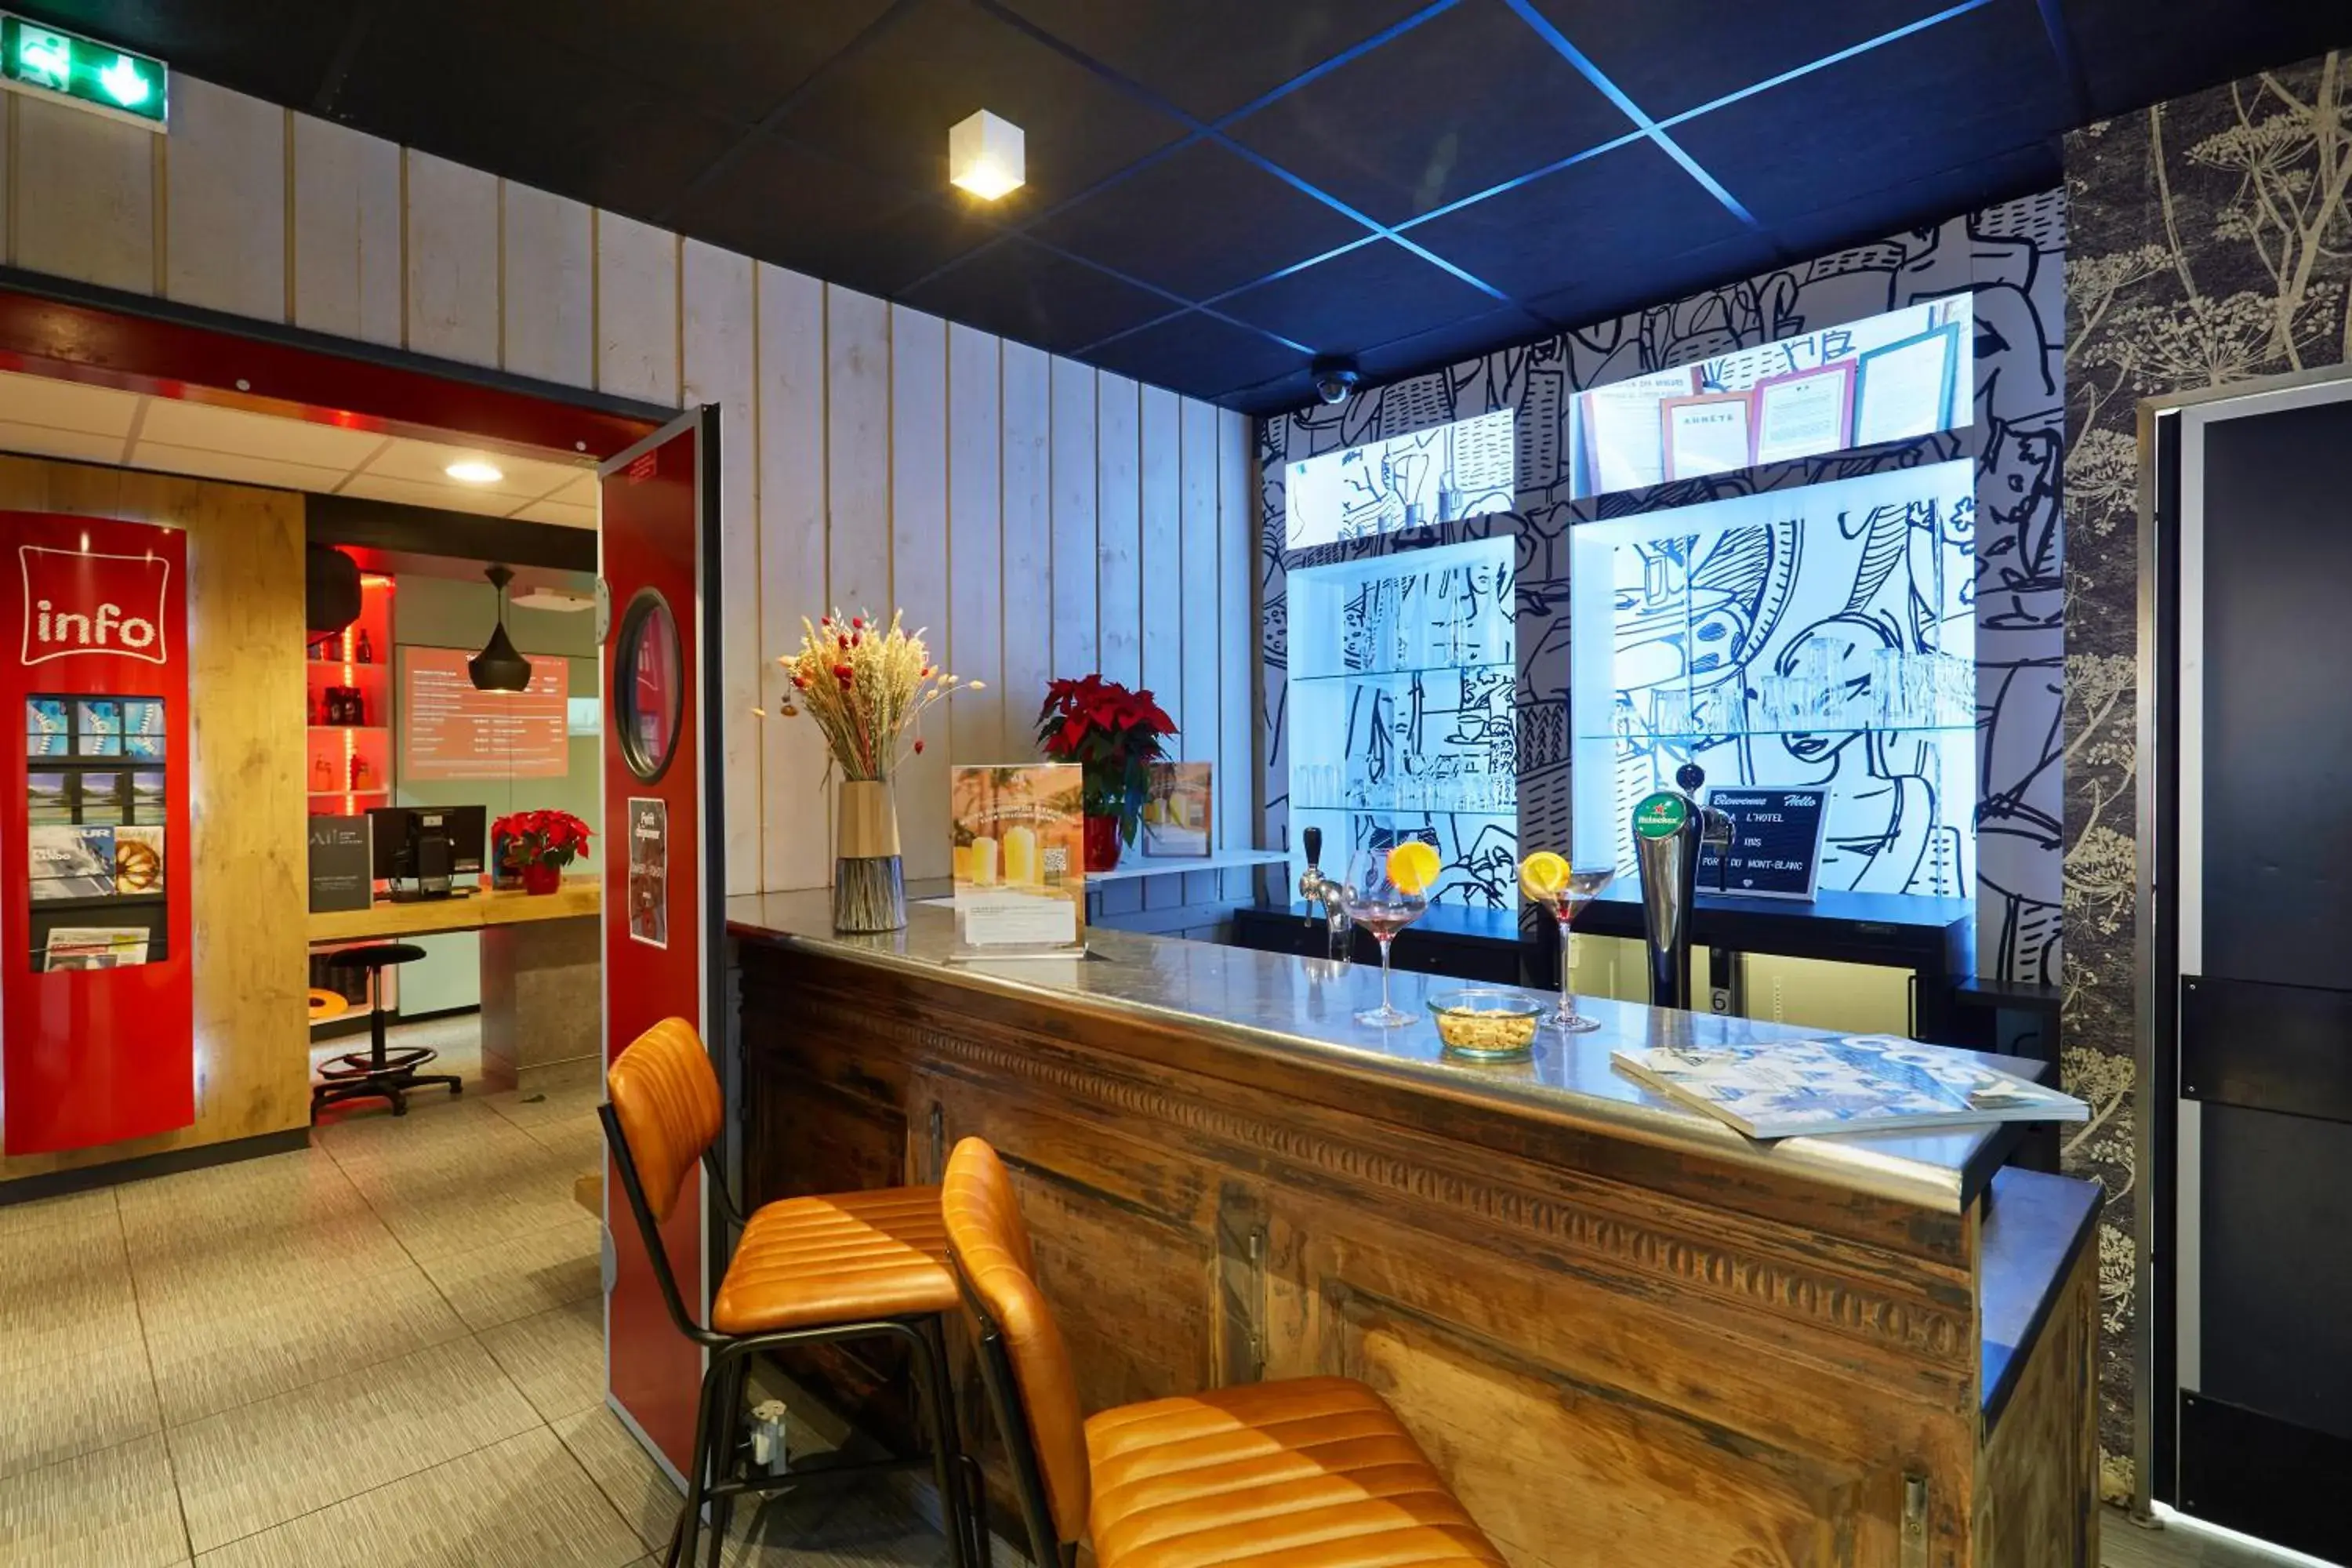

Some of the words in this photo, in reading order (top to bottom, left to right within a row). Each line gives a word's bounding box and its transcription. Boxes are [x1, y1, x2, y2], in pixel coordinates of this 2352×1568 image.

[38, 600, 155, 647] info
[1784, 794, 1816, 807] Hello
[1730, 858, 1742, 868] DU
[1748, 859, 1803, 871] MONT-BLANC
